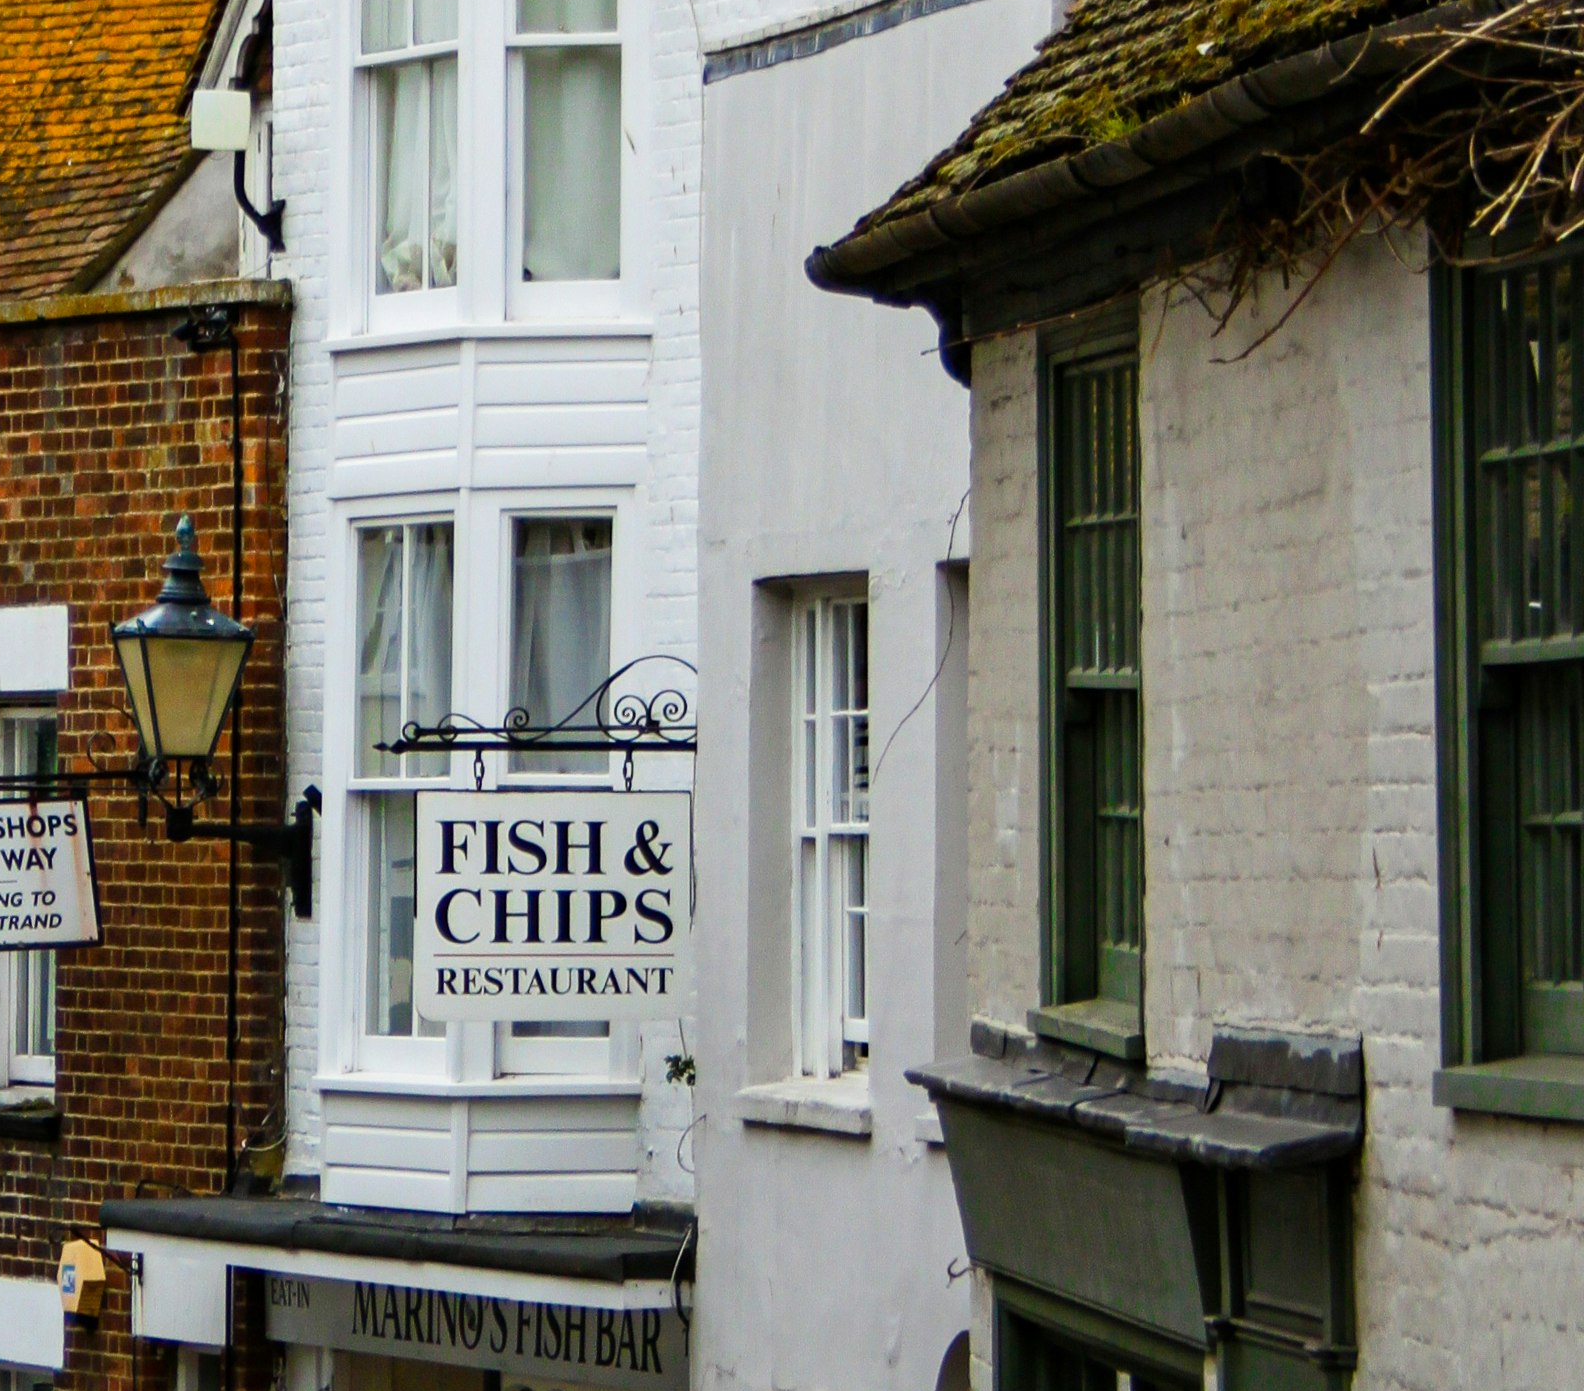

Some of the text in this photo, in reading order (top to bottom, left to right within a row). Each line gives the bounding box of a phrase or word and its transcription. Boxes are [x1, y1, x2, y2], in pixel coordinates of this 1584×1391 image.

[0, 847, 57, 871] WAY
[435, 819, 674, 876] FISH &
[31, 890, 56, 907] TO
[434, 888, 674, 945] CHIPS
[435, 967, 674, 996] RESTAURANT
[270, 1277, 311, 1308] EAT-IN
[351, 1280, 507, 1354] MARINO'S
[515, 1300, 587, 1364] FISH
[595, 1307, 663, 1375] BAR
